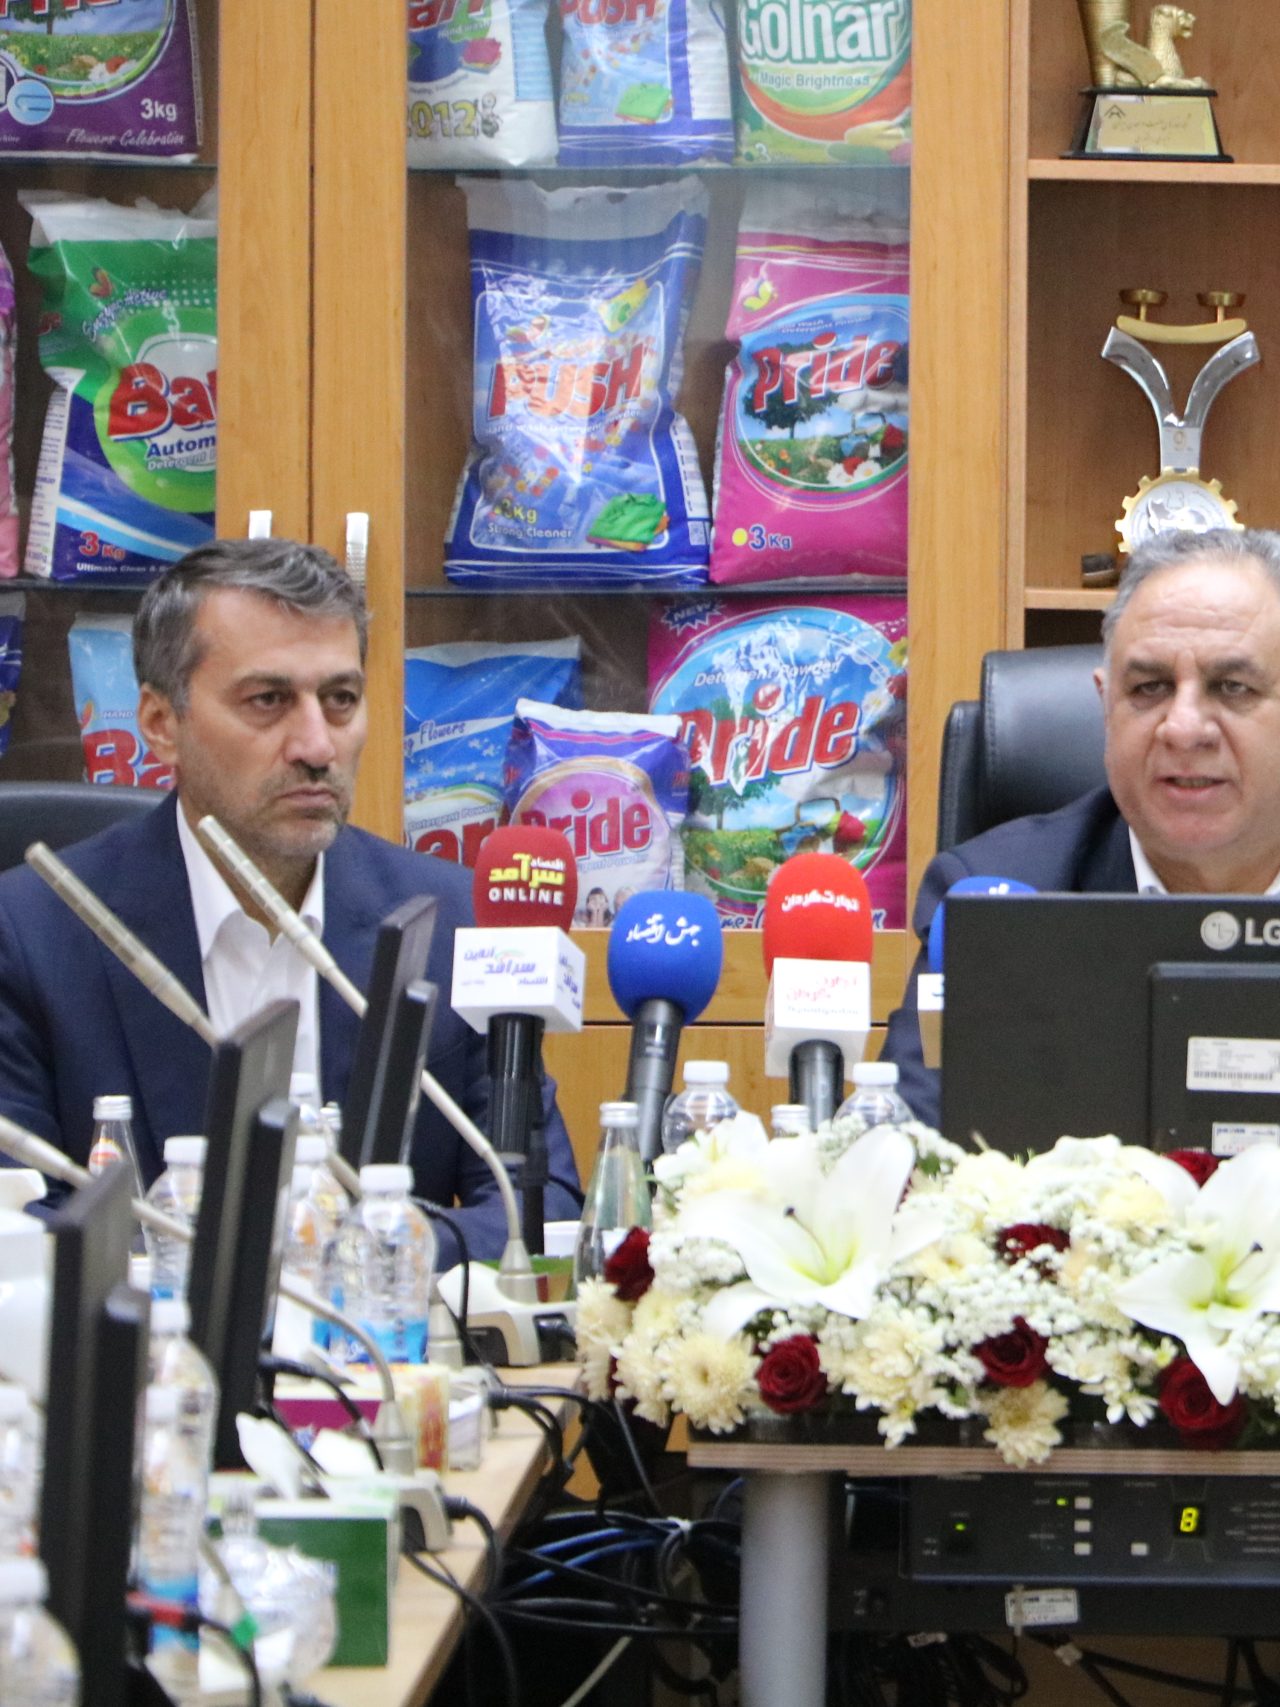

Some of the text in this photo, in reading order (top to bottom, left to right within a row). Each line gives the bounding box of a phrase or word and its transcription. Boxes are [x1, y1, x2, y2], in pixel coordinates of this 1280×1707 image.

[740, 0, 897, 60] Golnar
[760, 72, 871, 90] Magic Brightness
[140, 98, 178, 122] 3kg
[405, 99, 478, 138] 012
[486, 342, 647, 421] PUSH
[752, 332, 901, 416] Pride
[526, 527, 573, 538] Cleaner
[420, 720, 467, 745] Flowers
[681, 683, 863, 787] Pride
[488, 886, 564, 906] ONLINE
